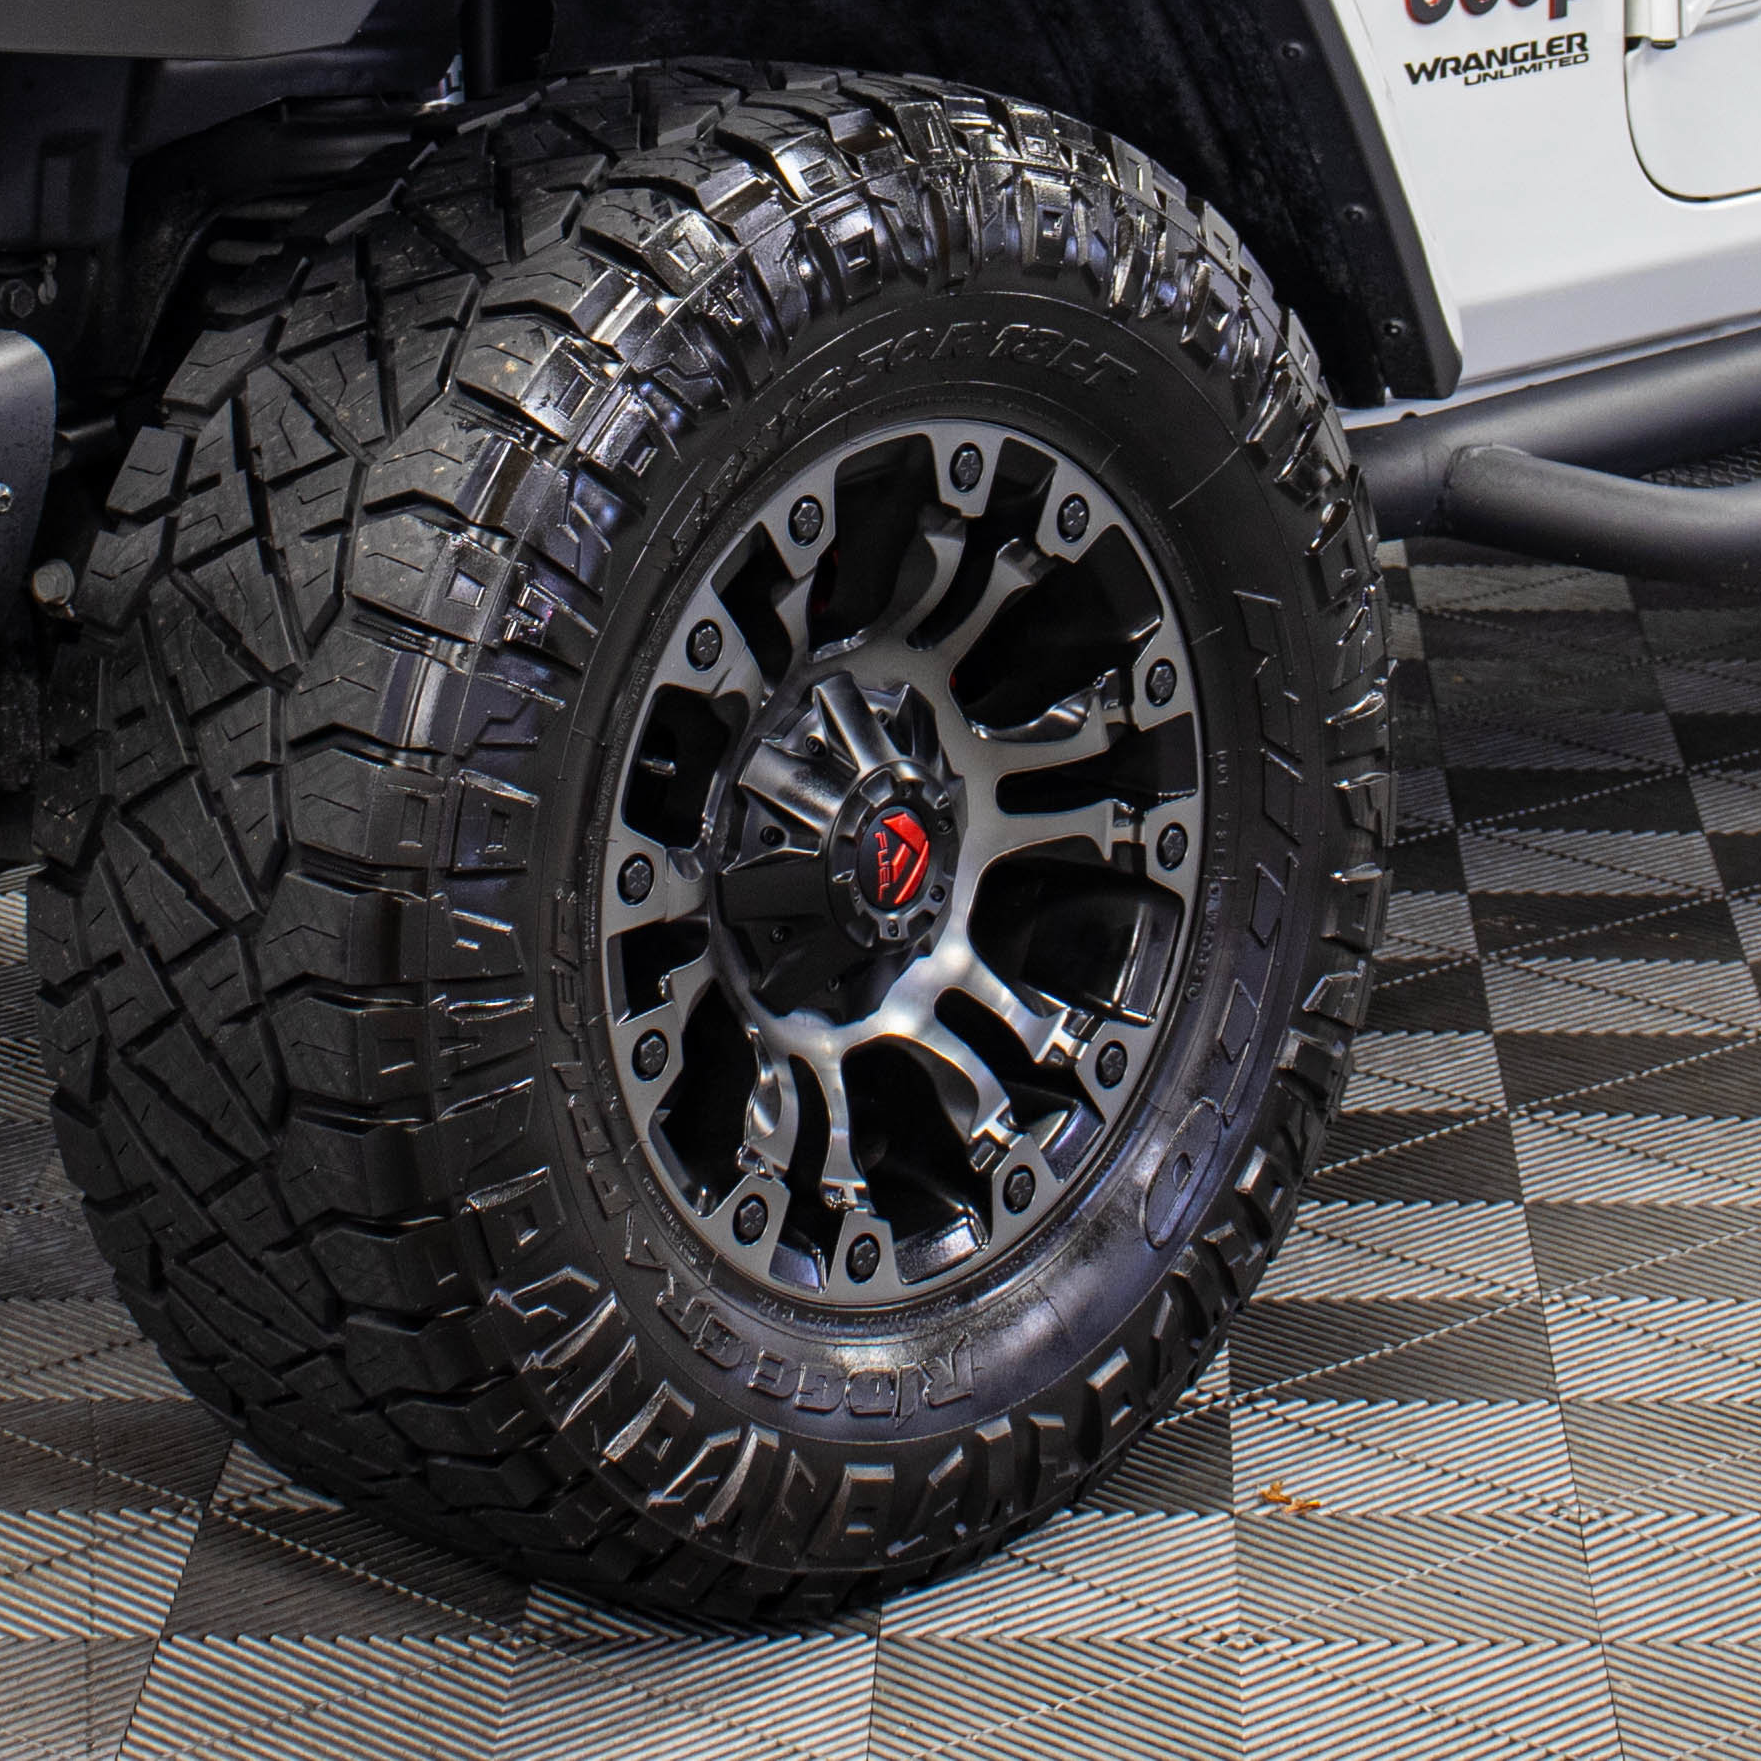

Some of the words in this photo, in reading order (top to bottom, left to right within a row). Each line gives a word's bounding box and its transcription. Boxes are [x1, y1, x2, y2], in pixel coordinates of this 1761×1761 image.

[1403, 31, 1589, 86] WRANGLER
[1463, 52, 1589, 86] UNLIMITED
[874, 831, 891, 902] FUEL
